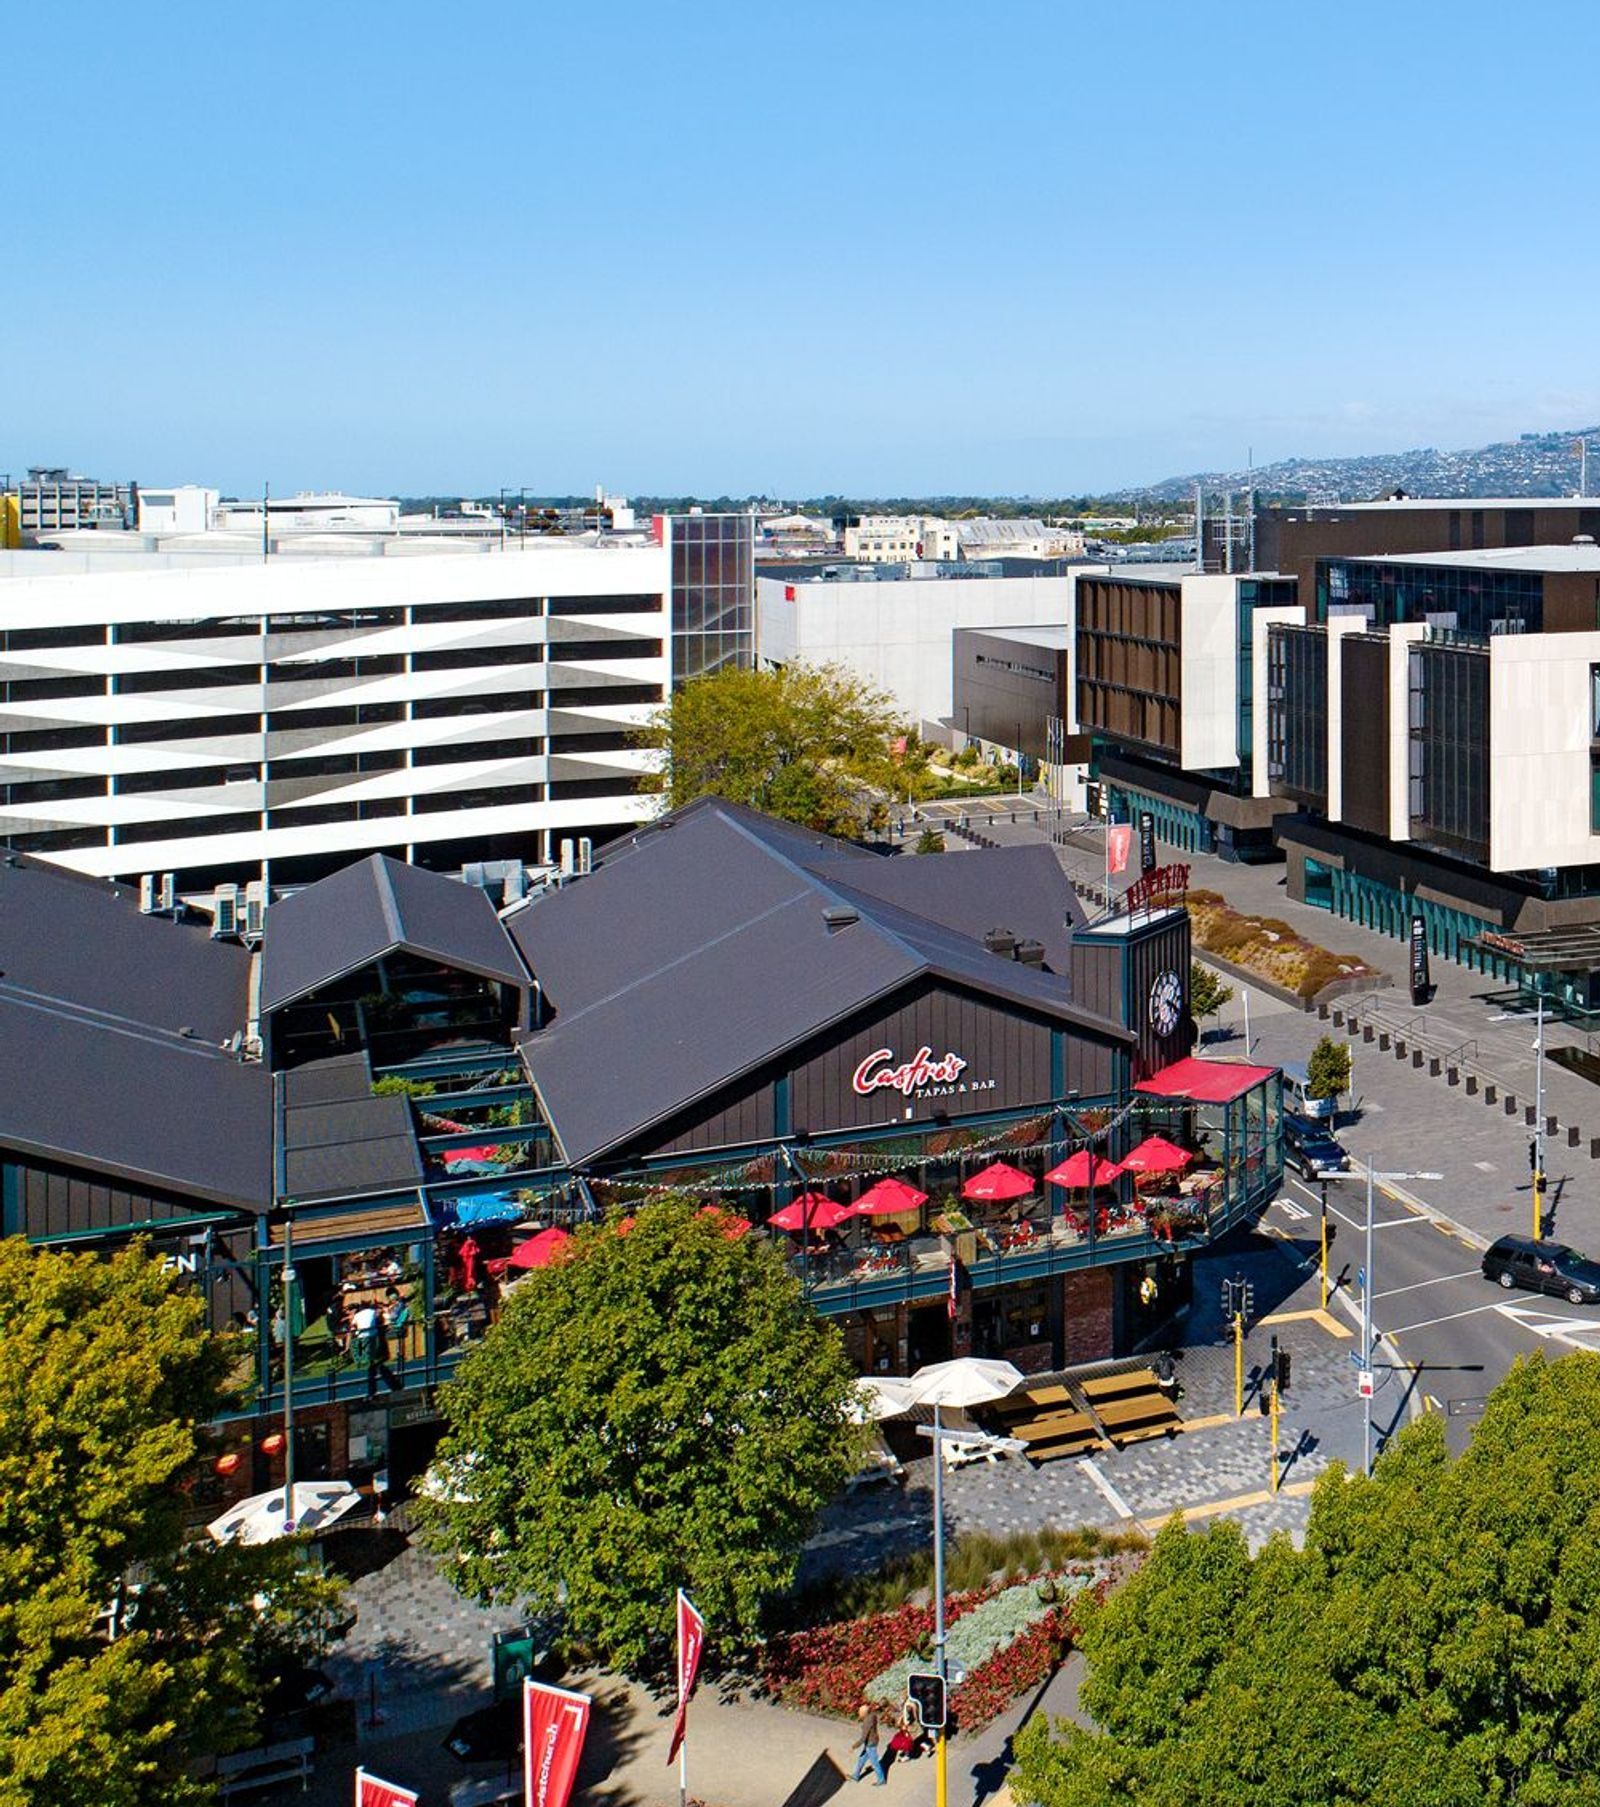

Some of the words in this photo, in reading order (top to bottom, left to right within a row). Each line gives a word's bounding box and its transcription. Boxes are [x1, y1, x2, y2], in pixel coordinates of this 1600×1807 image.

[1127, 863, 1191, 912] RIVERSIDE
[853, 1046, 967, 1095] Castro's
[916, 1084, 955, 1099] TAPAS
[958, 1083, 967, 1092] &
[972, 1080, 995, 1091] BAR
